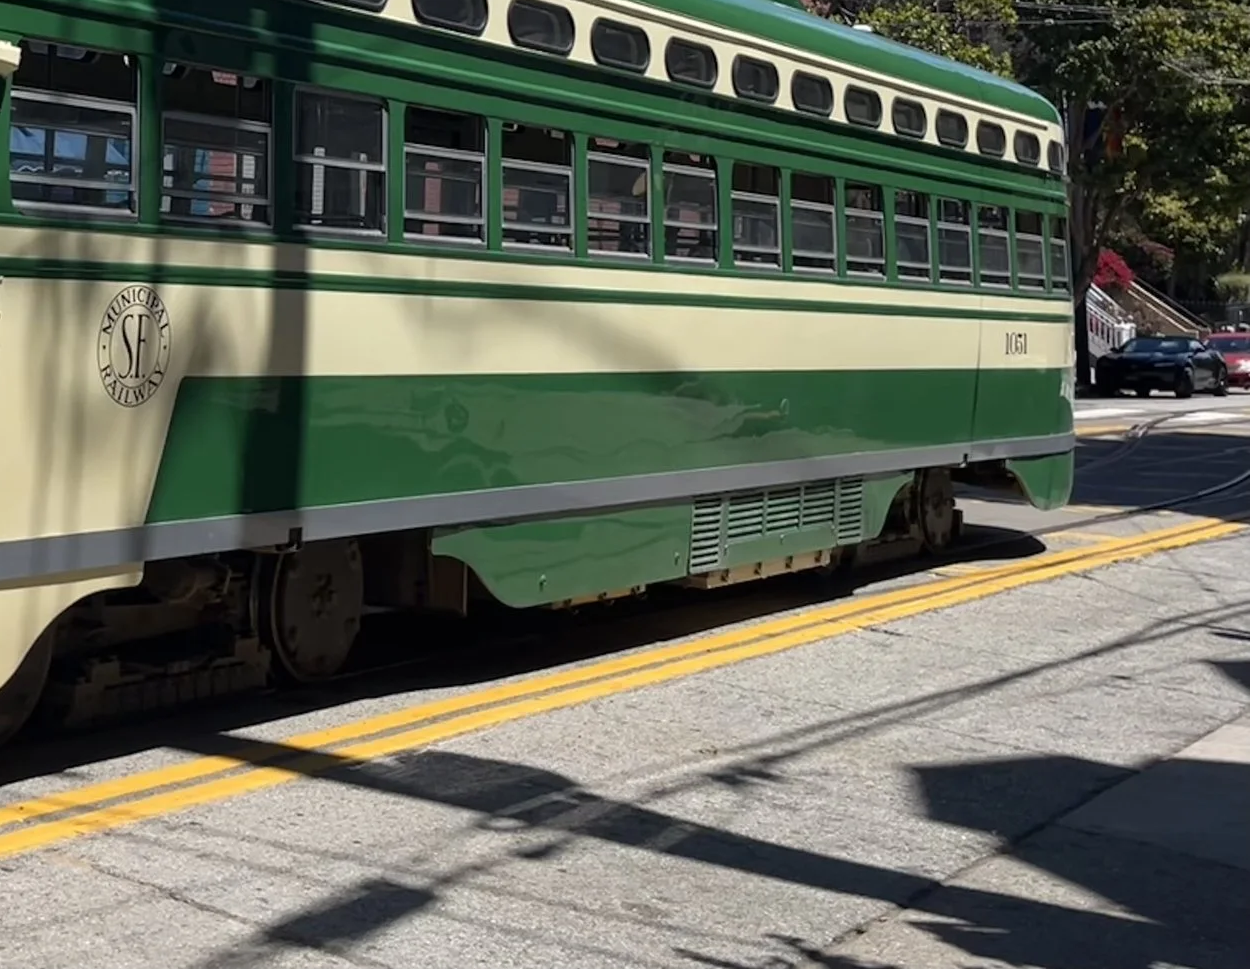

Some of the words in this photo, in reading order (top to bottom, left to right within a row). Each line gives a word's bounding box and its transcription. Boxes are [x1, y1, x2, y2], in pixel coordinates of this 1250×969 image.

[102, 288, 169, 338] MUNICIPAL
[1005, 332, 1028, 355] 1051
[101, 362, 164, 404] RAILWAY
